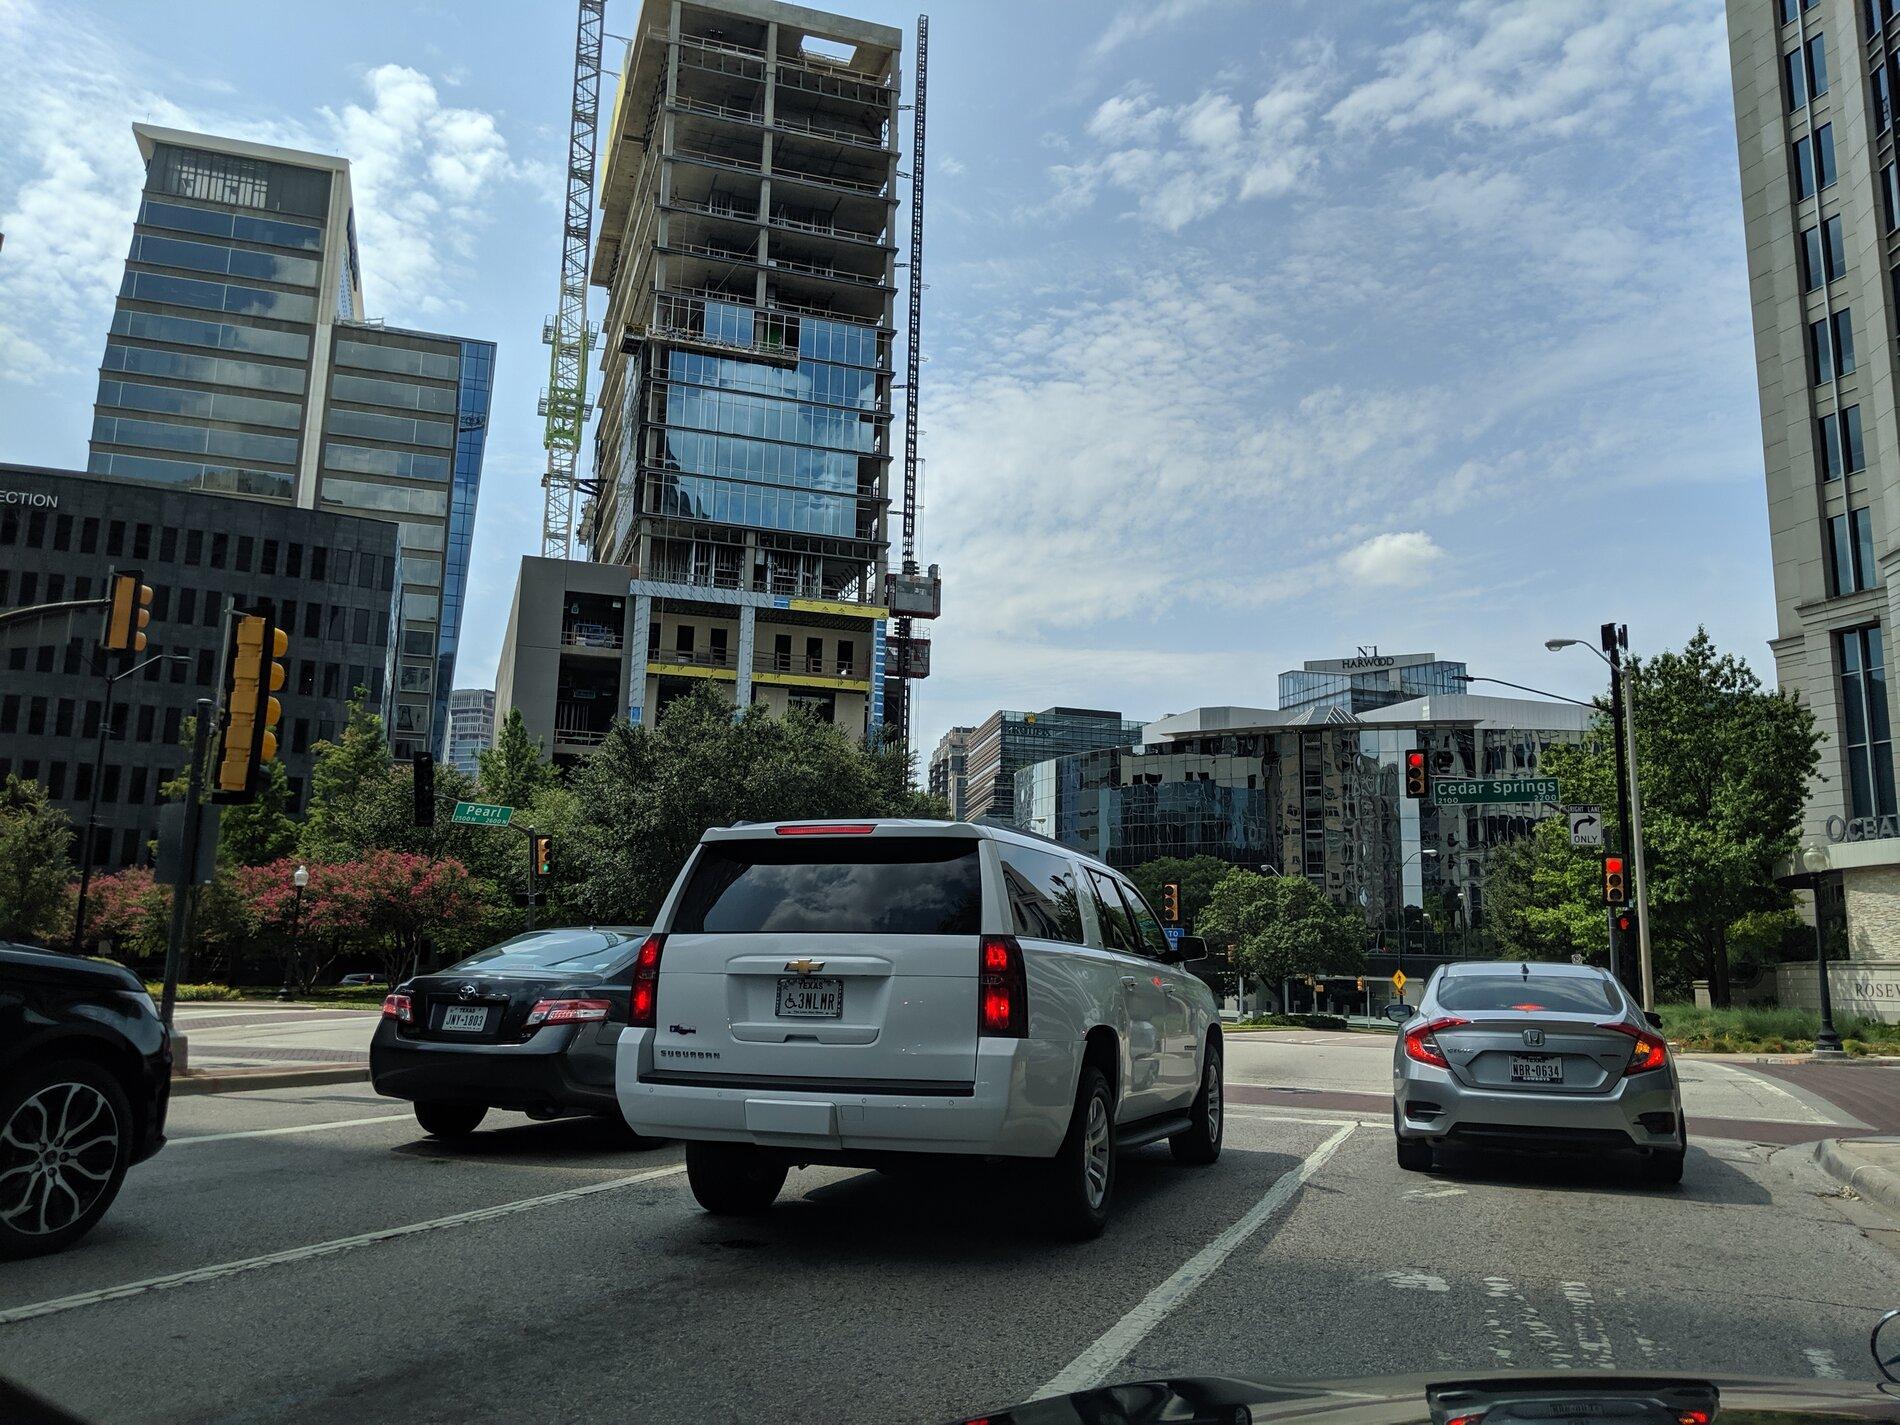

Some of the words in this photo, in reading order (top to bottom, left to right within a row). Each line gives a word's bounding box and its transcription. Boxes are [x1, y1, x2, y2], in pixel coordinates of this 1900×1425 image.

[1342, 657, 1395, 669] HARWOOD
[1437, 782, 1484, 795] Cedar
[1493, 780, 1556, 796] Springs
[466, 805, 502, 818] Pearl
[1574, 835, 1598, 844] ONLY
[799, 981, 824, 990] TEXAS
[660, 1050, 721, 1060] SUBURBAN
